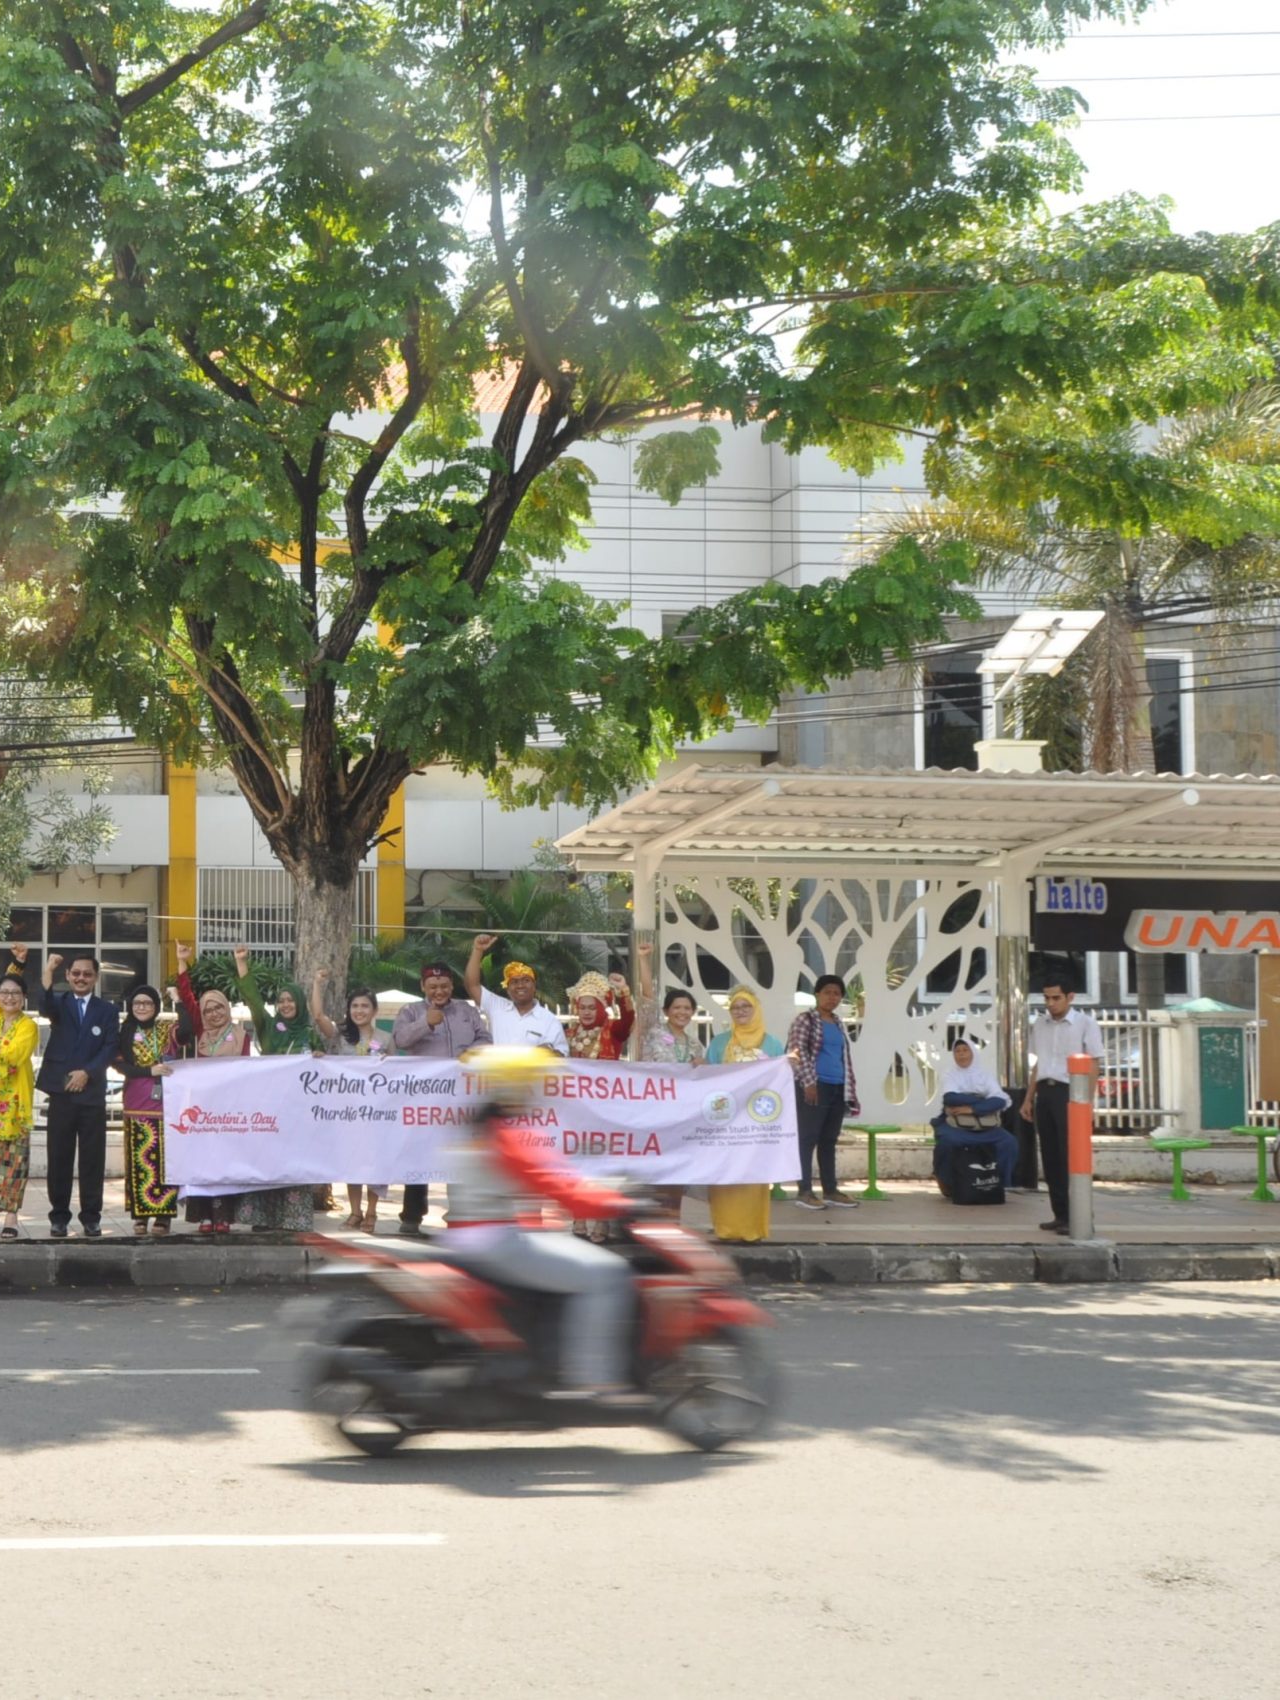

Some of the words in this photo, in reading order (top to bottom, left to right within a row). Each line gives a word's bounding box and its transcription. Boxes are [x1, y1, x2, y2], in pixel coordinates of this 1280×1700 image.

[1046, 878, 1105, 910] halte
[299, 1071, 367, 1097] Korban
[543, 1075, 677, 1101] BERSALAH
[250, 1111, 278, 1128] Day
[357, 1104, 398, 1122] Harus
[729, 1125, 750, 1134] Studi
[563, 1130, 662, 1156] DIBELA
